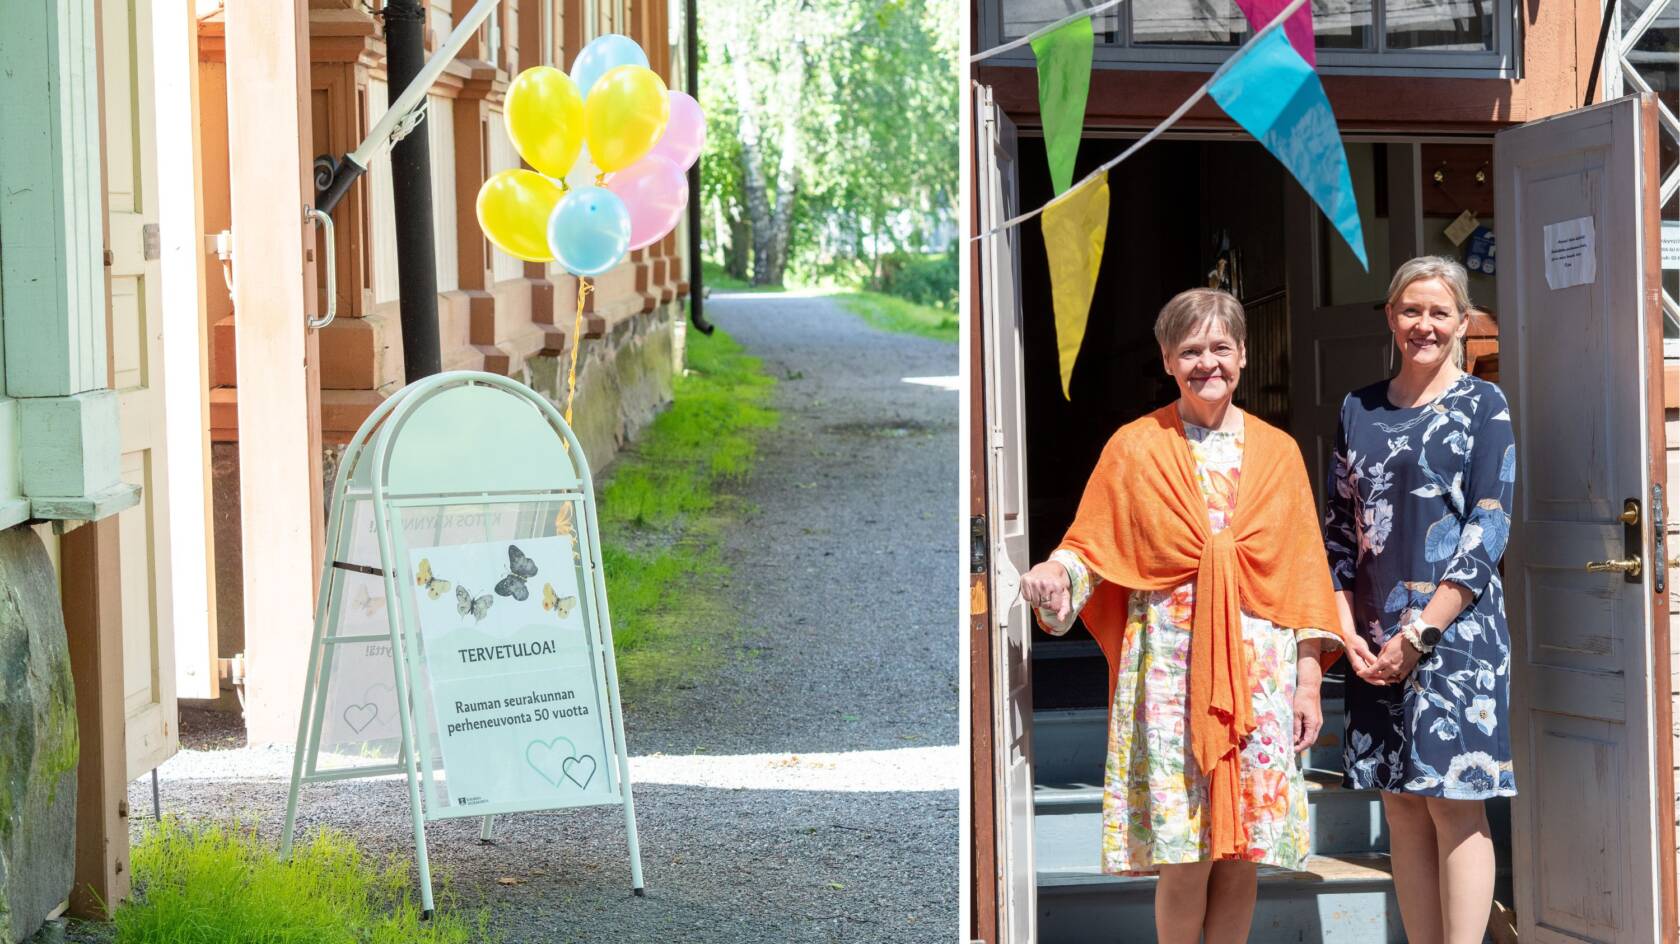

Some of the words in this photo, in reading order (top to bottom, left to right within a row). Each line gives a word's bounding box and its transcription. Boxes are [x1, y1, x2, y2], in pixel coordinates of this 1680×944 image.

[458, 639, 556, 663] TERVETULOA!
[455, 698, 501, 713] Rauman
[504, 689, 575, 708] seurakunnan
[447, 712, 532, 736] perheneuvonta
[534, 708, 550, 721] 50
[552, 705, 589, 719] vuotta
